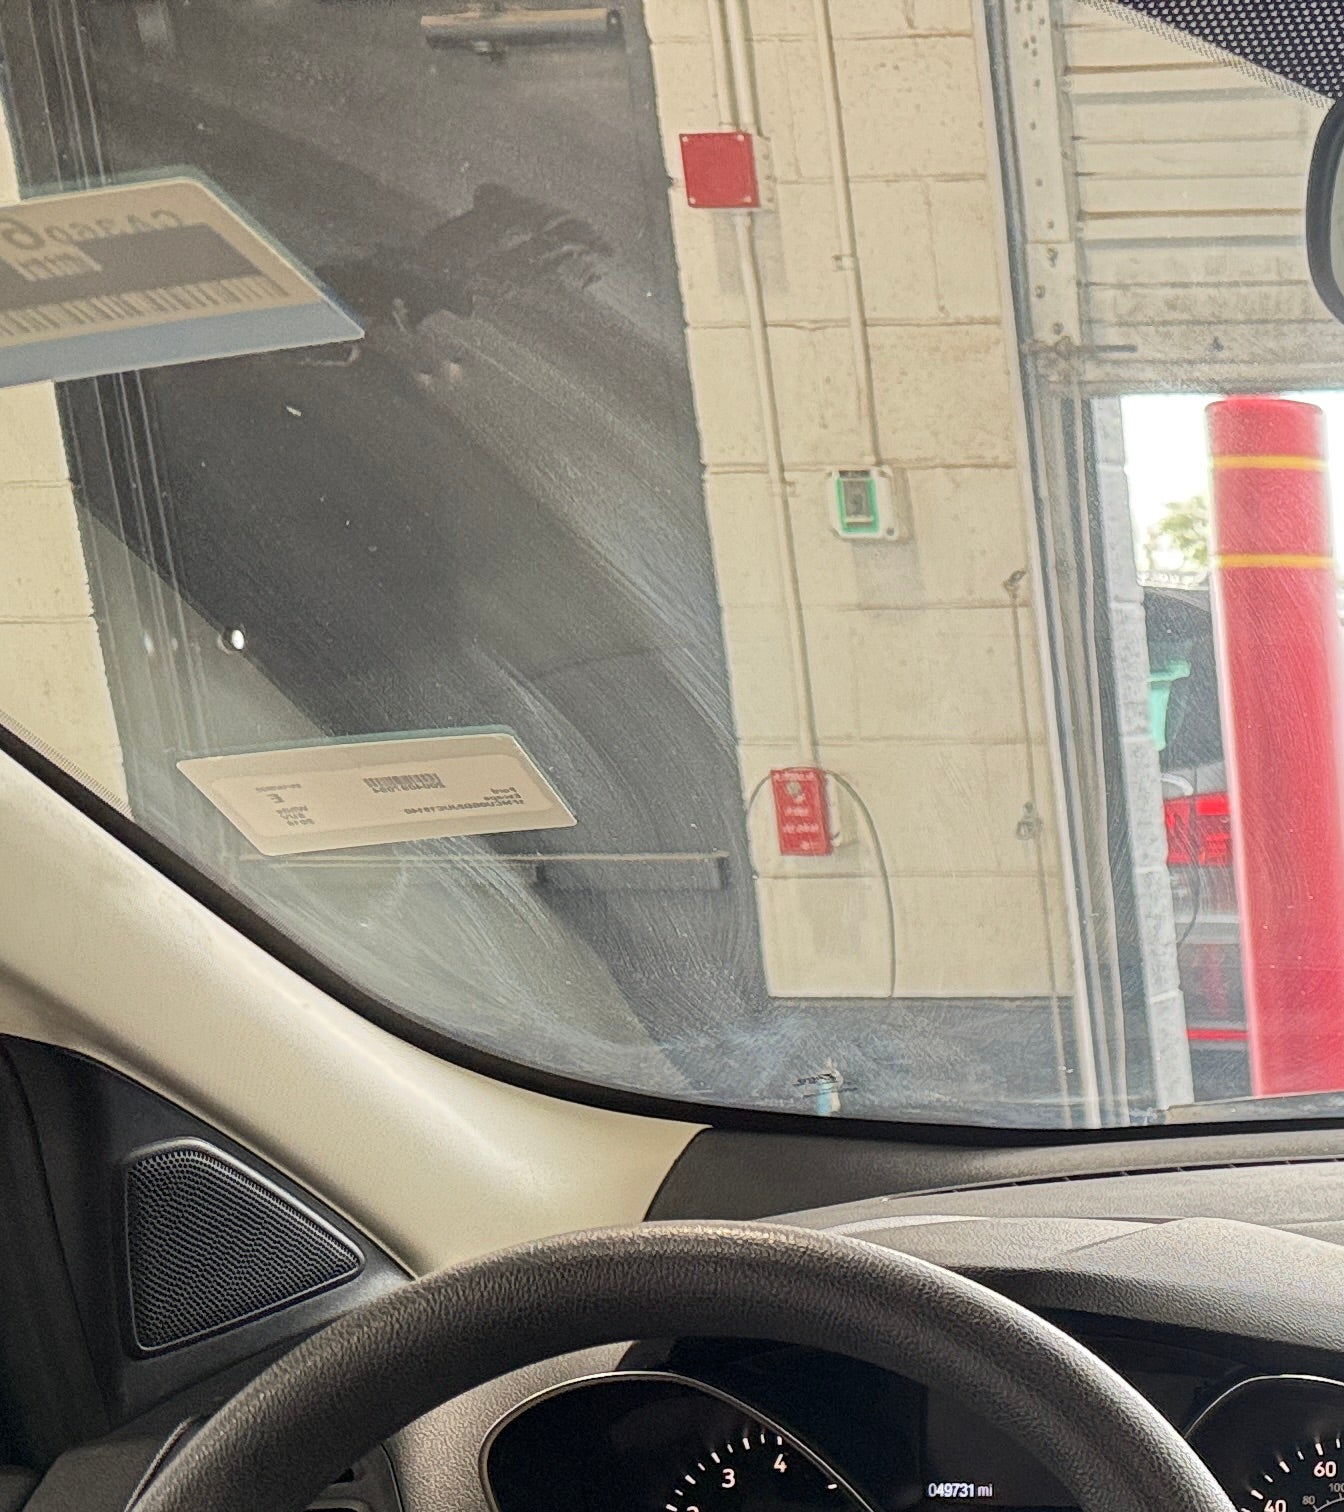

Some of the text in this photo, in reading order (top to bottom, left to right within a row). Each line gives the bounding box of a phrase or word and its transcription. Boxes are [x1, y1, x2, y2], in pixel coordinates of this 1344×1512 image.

[774, 1454, 787, 1473] 4
[1314, 1461, 1337, 1478] 60
[722, 1468, 735, 1488] 3
[928, 1483, 993, 1498] 049731 mi
[1302, 1494, 1315, 1505] 80
